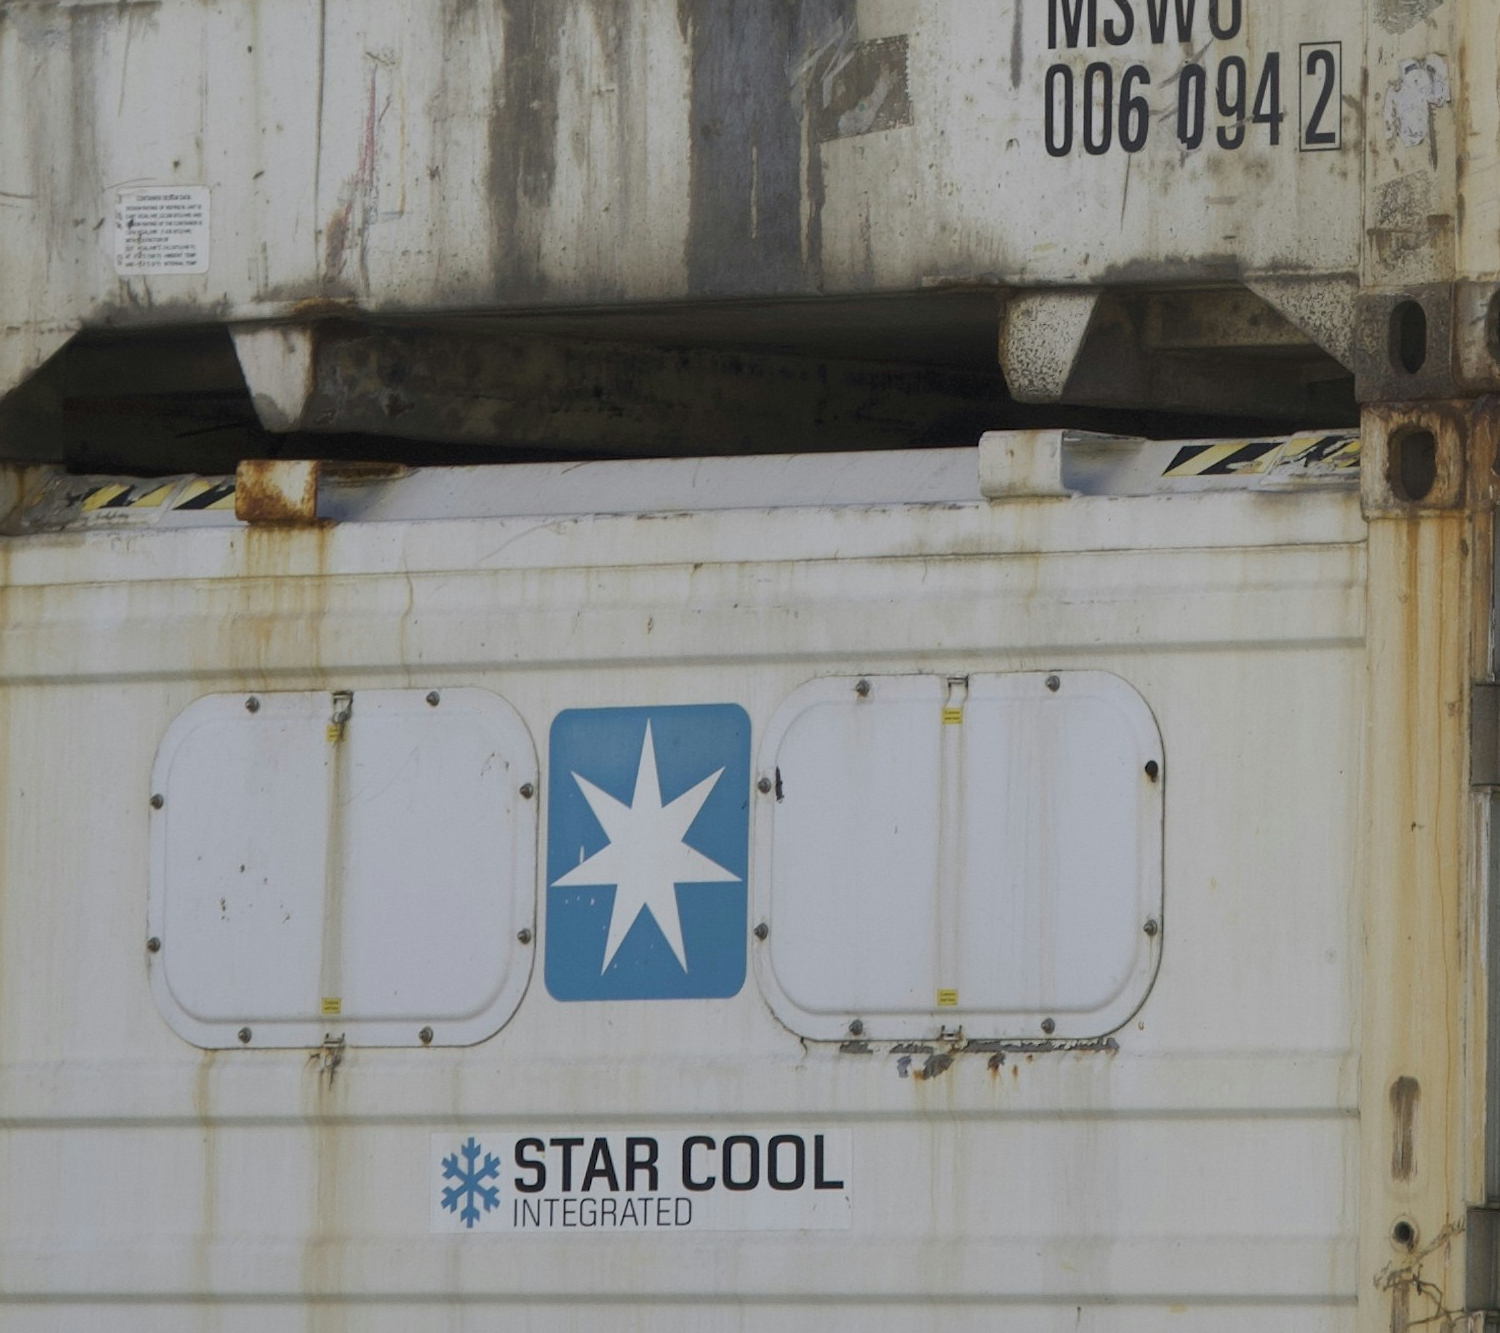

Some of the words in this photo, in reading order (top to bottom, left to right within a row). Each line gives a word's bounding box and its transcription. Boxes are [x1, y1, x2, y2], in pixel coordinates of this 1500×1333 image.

[1044, 61, 1150, 158] 006
[1176, 51, 1285, 150] 094
[1303, 48, 1336, 144] 2
[513, 1134, 662, 1193] STAR
[681, 1132, 843, 1192] COOL
[513, 1195, 694, 1229] INTEGRATED
